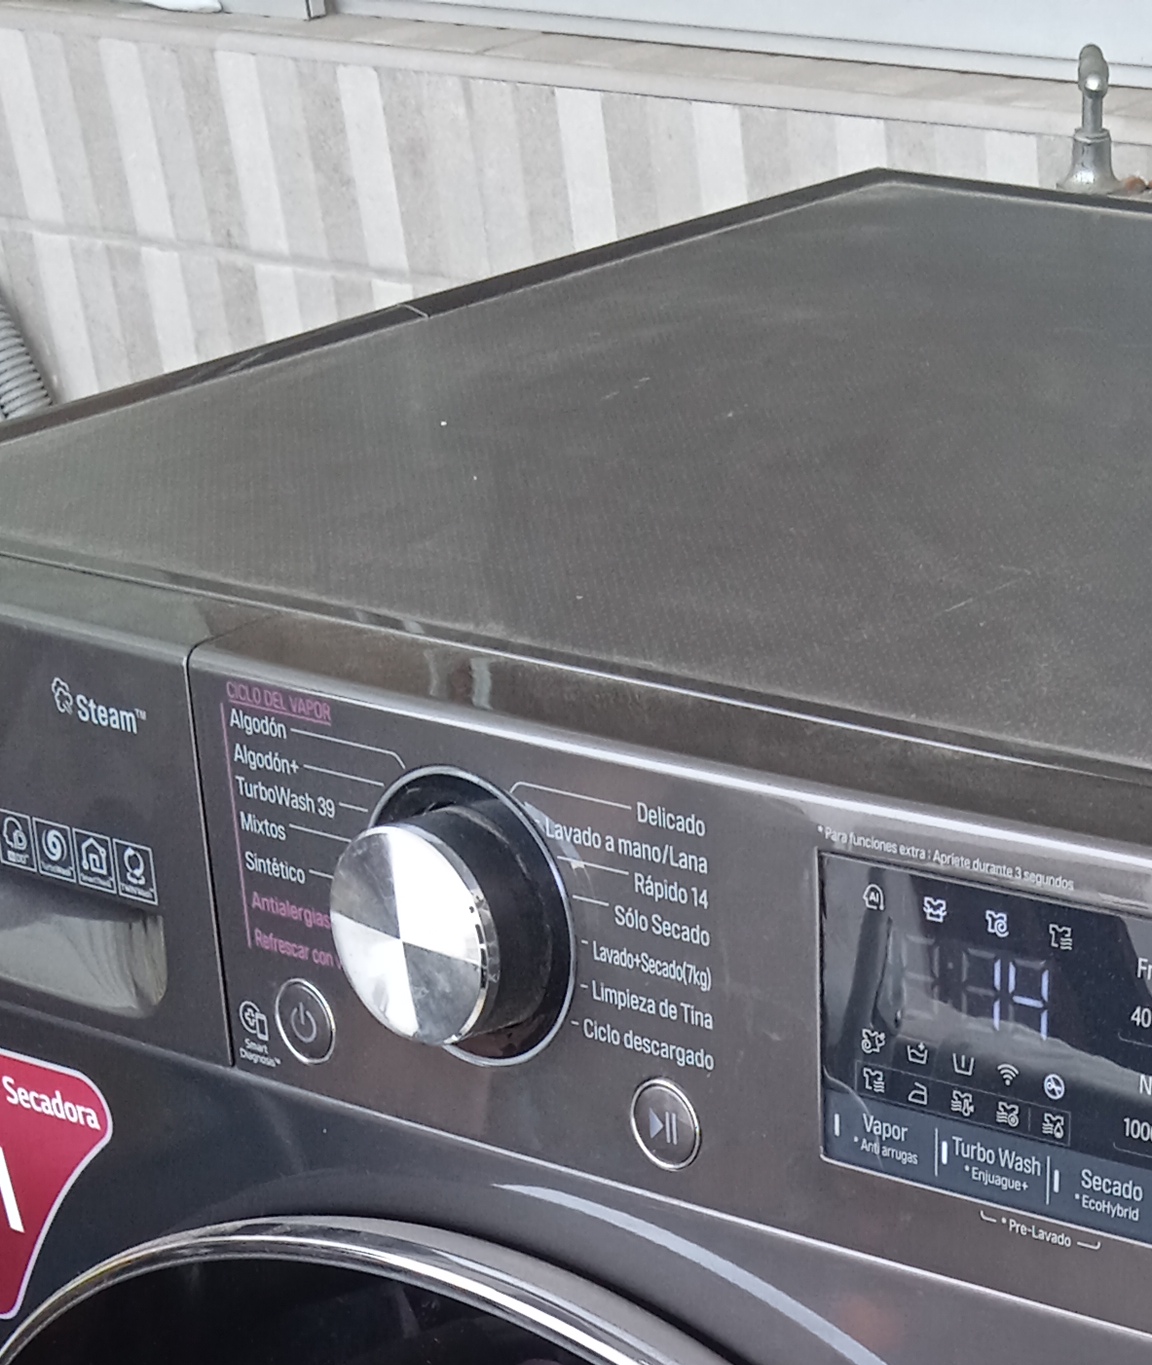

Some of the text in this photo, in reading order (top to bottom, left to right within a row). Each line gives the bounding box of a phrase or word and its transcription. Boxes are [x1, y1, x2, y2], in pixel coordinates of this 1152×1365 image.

[226, 681, 331, 721] CICLO DEL VAPOR
[230, 708, 287, 739] Algodón
[234, 743, 299, 774] Algodón+
[236, 776, 335, 818] TurboWash 39
[240, 811, 286, 840] Mixtos
[637, 801, 706, 837] Delicado
[545, 816, 708, 874] Lavado a mano/Lana
[825, 827, 848, 844] Para
[850, 831, 898, 855] funciones
[973, 857, 1014, 879] durante
[1015, 866, 1023, 880] 3
[1024, 869, 1075, 891] segundos
[245, 851, 306, 884] Sintético
[634, 872, 708, 909] Rápido 14
[614, 904, 711, 947] Sólo Secado
[254, 927, 309, 960] Refrescar
[312, 948, 334, 967] con
[593, 940, 712, 992] Lavado+Secado(7kg)
[592, 980, 713, 1030] Limpieza de Tina
[583, 1018, 715, 1070] Ciclo descargado
[2, 1075, 101, 1131] Secadora
[863, 1113, 908, 1142] Vapor
[881, 1145, 919, 1166] arrugas
[952, 1135, 1042, 1177] Turbo Wash
[971, 1165, 1029, 1192] Enjuague+
[1081, 1168, 1144, 1202] Secado
[1081, 1194, 1139, 1222] EcoHybrid
[1008, 1217, 1072, 1248] Pre-Lavado
